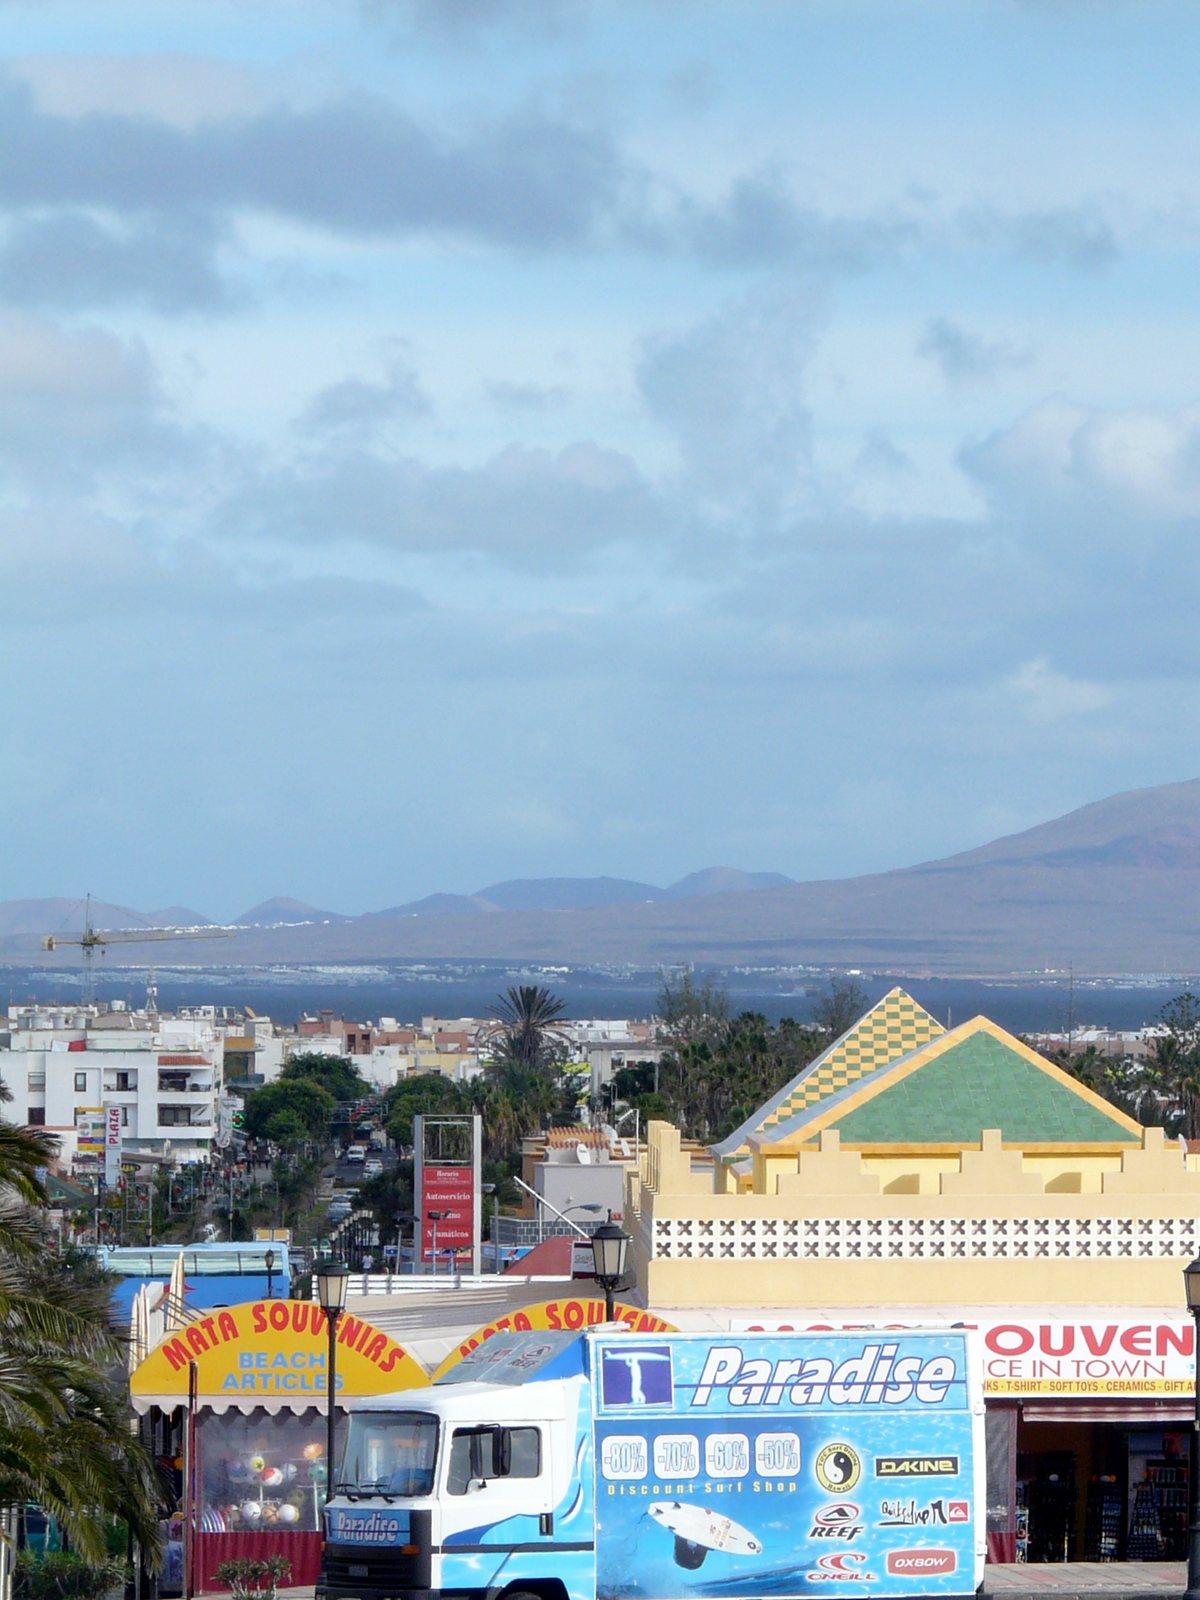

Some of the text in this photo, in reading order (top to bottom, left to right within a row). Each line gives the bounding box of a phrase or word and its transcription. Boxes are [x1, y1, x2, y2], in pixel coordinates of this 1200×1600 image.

[109, 1109, 119, 1144] PLAZA
[425, 1192, 471, 1200] Autoservicio
[426, 1229, 469, 1238] Numáticos
[161, 1311, 239, 1372] MATA
[239, 1352, 325, 1369] BEACH
[1032, 1360, 1061, 1377] IN
[1071, 1359, 1165, 1377] TOWN
[222, 1374, 345, 1391] ARTICLES
[690, 1344, 957, 1406] Paradise
[1006, 1381, 1042, 1391] T-SHIRT
[1050, 1381, 1073, 1391] SOFT
[1076, 1381, 1098, 1391] TOYS
[1106, 1381, 1156, 1391] CERAMICS
[1164, 1381, 1184, 1391] GIFT
[604, 1439, 798, 1473] -80% -70% -60% -50%
[879, 1460, 956, 1473] DAKINE
[607, 1480, 797, 1495] Discount Surf Shop
[337, 1512, 399, 1541] Paradise
[810, 1526, 864, 1541] REEF
[895, 1557, 948, 1568] OXBOW
